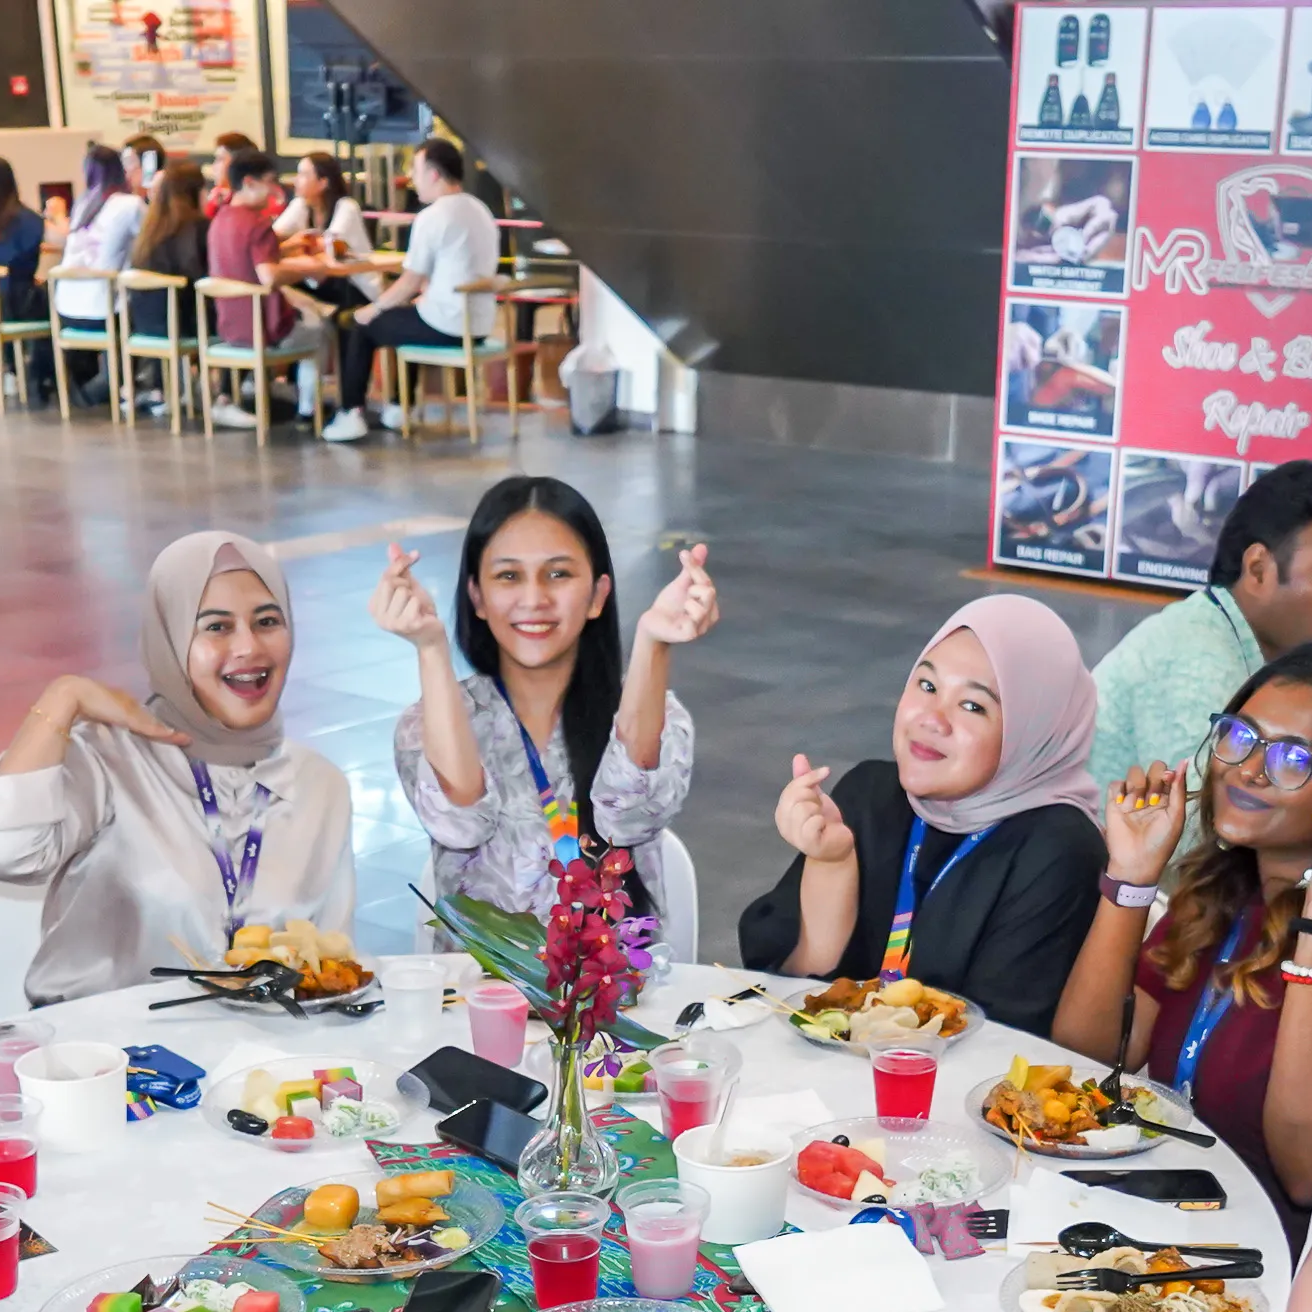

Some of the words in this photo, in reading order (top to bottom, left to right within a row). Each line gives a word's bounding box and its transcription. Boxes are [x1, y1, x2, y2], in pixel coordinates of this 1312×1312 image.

[1132, 226, 1210, 295] MR
[1202, 389, 1312, 456] Repair
[1137, 560, 1208, 583] ENGRAVING
